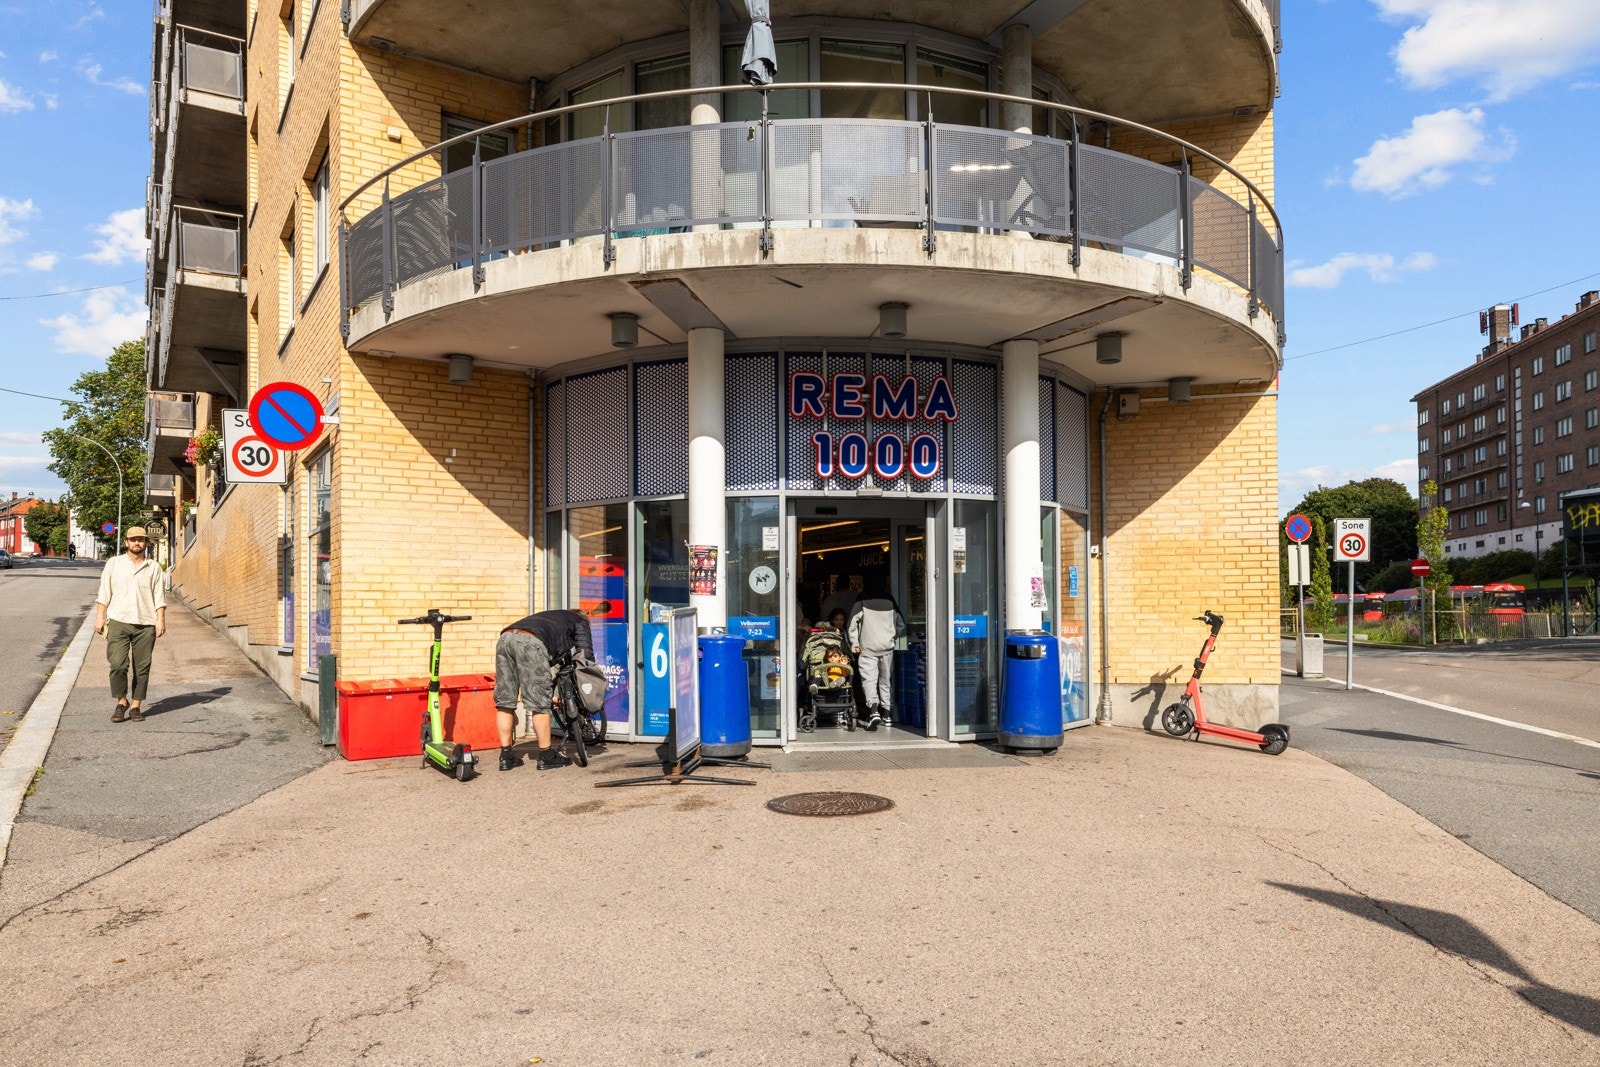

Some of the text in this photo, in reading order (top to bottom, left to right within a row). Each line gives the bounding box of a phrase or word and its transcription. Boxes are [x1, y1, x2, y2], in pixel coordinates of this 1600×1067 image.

[789, 371, 958, 422] REMA
[241, 446, 270, 466] 30
[811, 430, 940, 480] 1000
[1342, 521, 1364, 529] Sone
[1345, 540, 1361, 551] 30
[857, 552, 884, 567] JUICE
[748, 628, 763, 636] 7-23
[651, 632, 668, 678] 6
[599, 665, 624, 675] DAGS-
